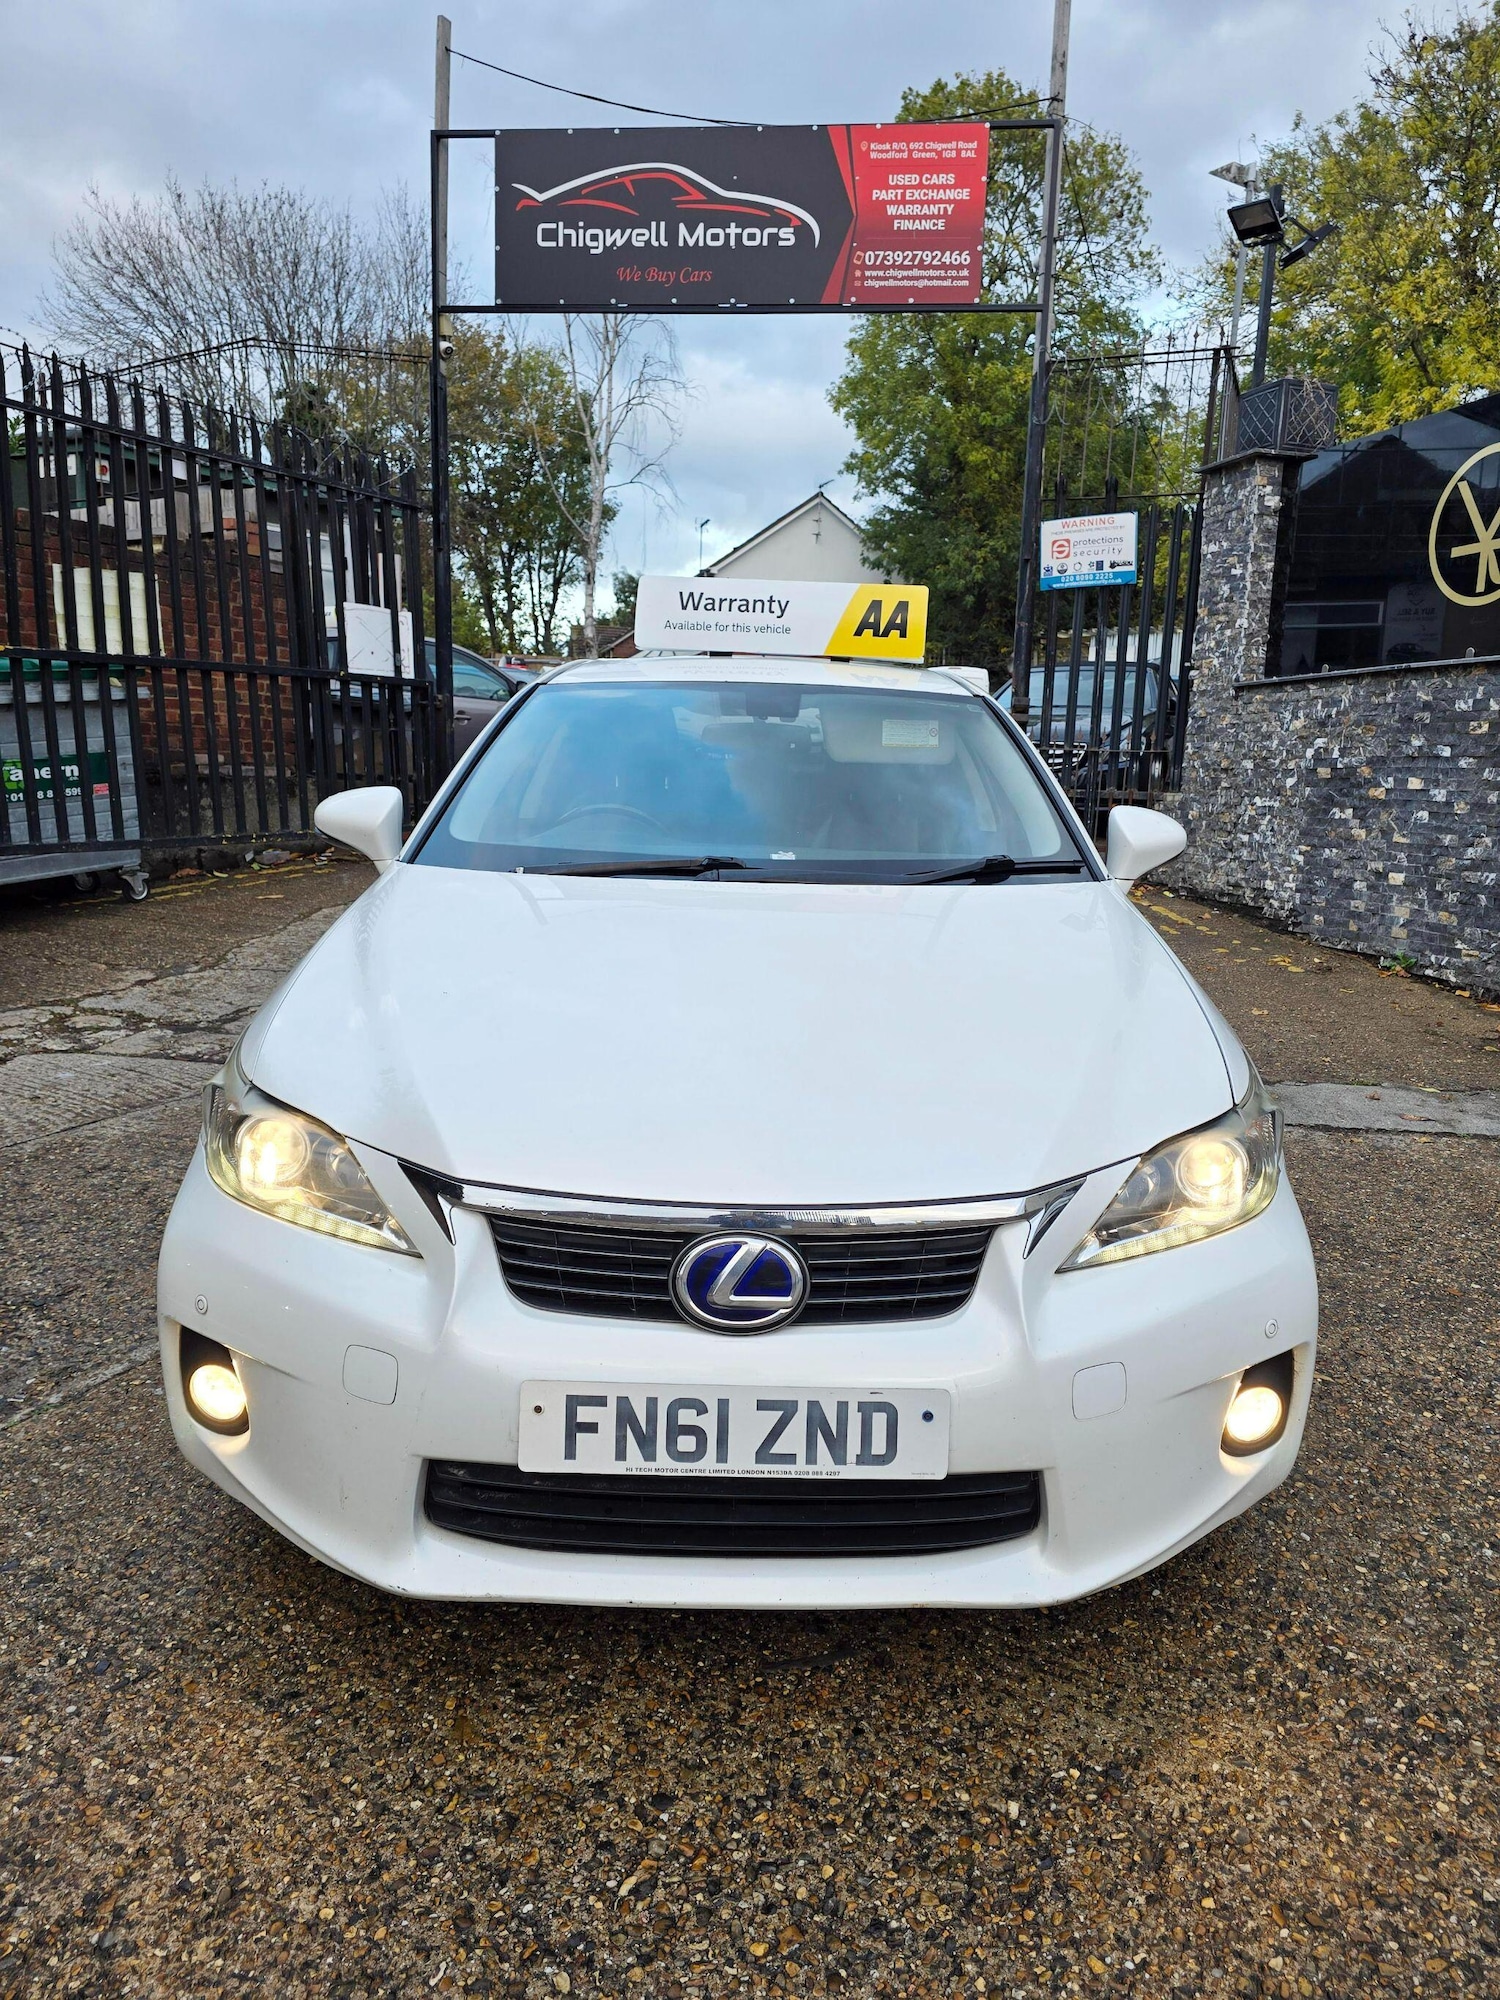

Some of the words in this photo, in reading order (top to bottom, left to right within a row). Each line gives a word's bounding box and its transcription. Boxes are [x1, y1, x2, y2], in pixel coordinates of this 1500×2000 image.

[870, 142, 891, 150] Kiosk
[892, 142, 908, 151] R/O,
[910, 141, 923, 150] 692
[925, 141, 956, 151] Chigwell
[958, 141, 977, 149] Road
[870, 151, 908, 159] Woodford
[912, 151, 938, 159] Green,
[943, 150, 956, 158] IG8
[961, 150, 976, 158] 8AL
[889, 175, 919, 185] USED
[922, 174, 955, 184] CARS
[872, 190, 903, 200] PART
[906, 189, 970, 200] EXCHANGE
[886, 204, 954, 215] WARRANTY
[893, 219, 945, 230] FINANCE
[536, 221, 668, 255] Chigwell
[678, 222, 796, 248] Motors
[864, 250, 971, 265] 07392792466
[616, 265, 641, 282] We
[645, 267, 675, 287] Buy
[679, 266, 712, 283] Cars
[864, 268, 969, 278] www.chigwellmotors.co.uk
[864, 279, 969, 288] chigwellmotors@hotmail.com
[1061, 517, 1115, 529] WARNING
[1072, 536, 1124, 548] protections
[1073, 547, 1123, 557] security
[679, 591, 790, 618] Warranty
[853, 600, 909, 639] AA
[664, 620, 712, 632] Available
[714, 621, 730, 632] for
[731, 621, 751, 633] this
[754, 623, 791, 635] vehicle
[563, 1394, 731, 1464] FN61
[755, 1399, 898, 1467] ZND
